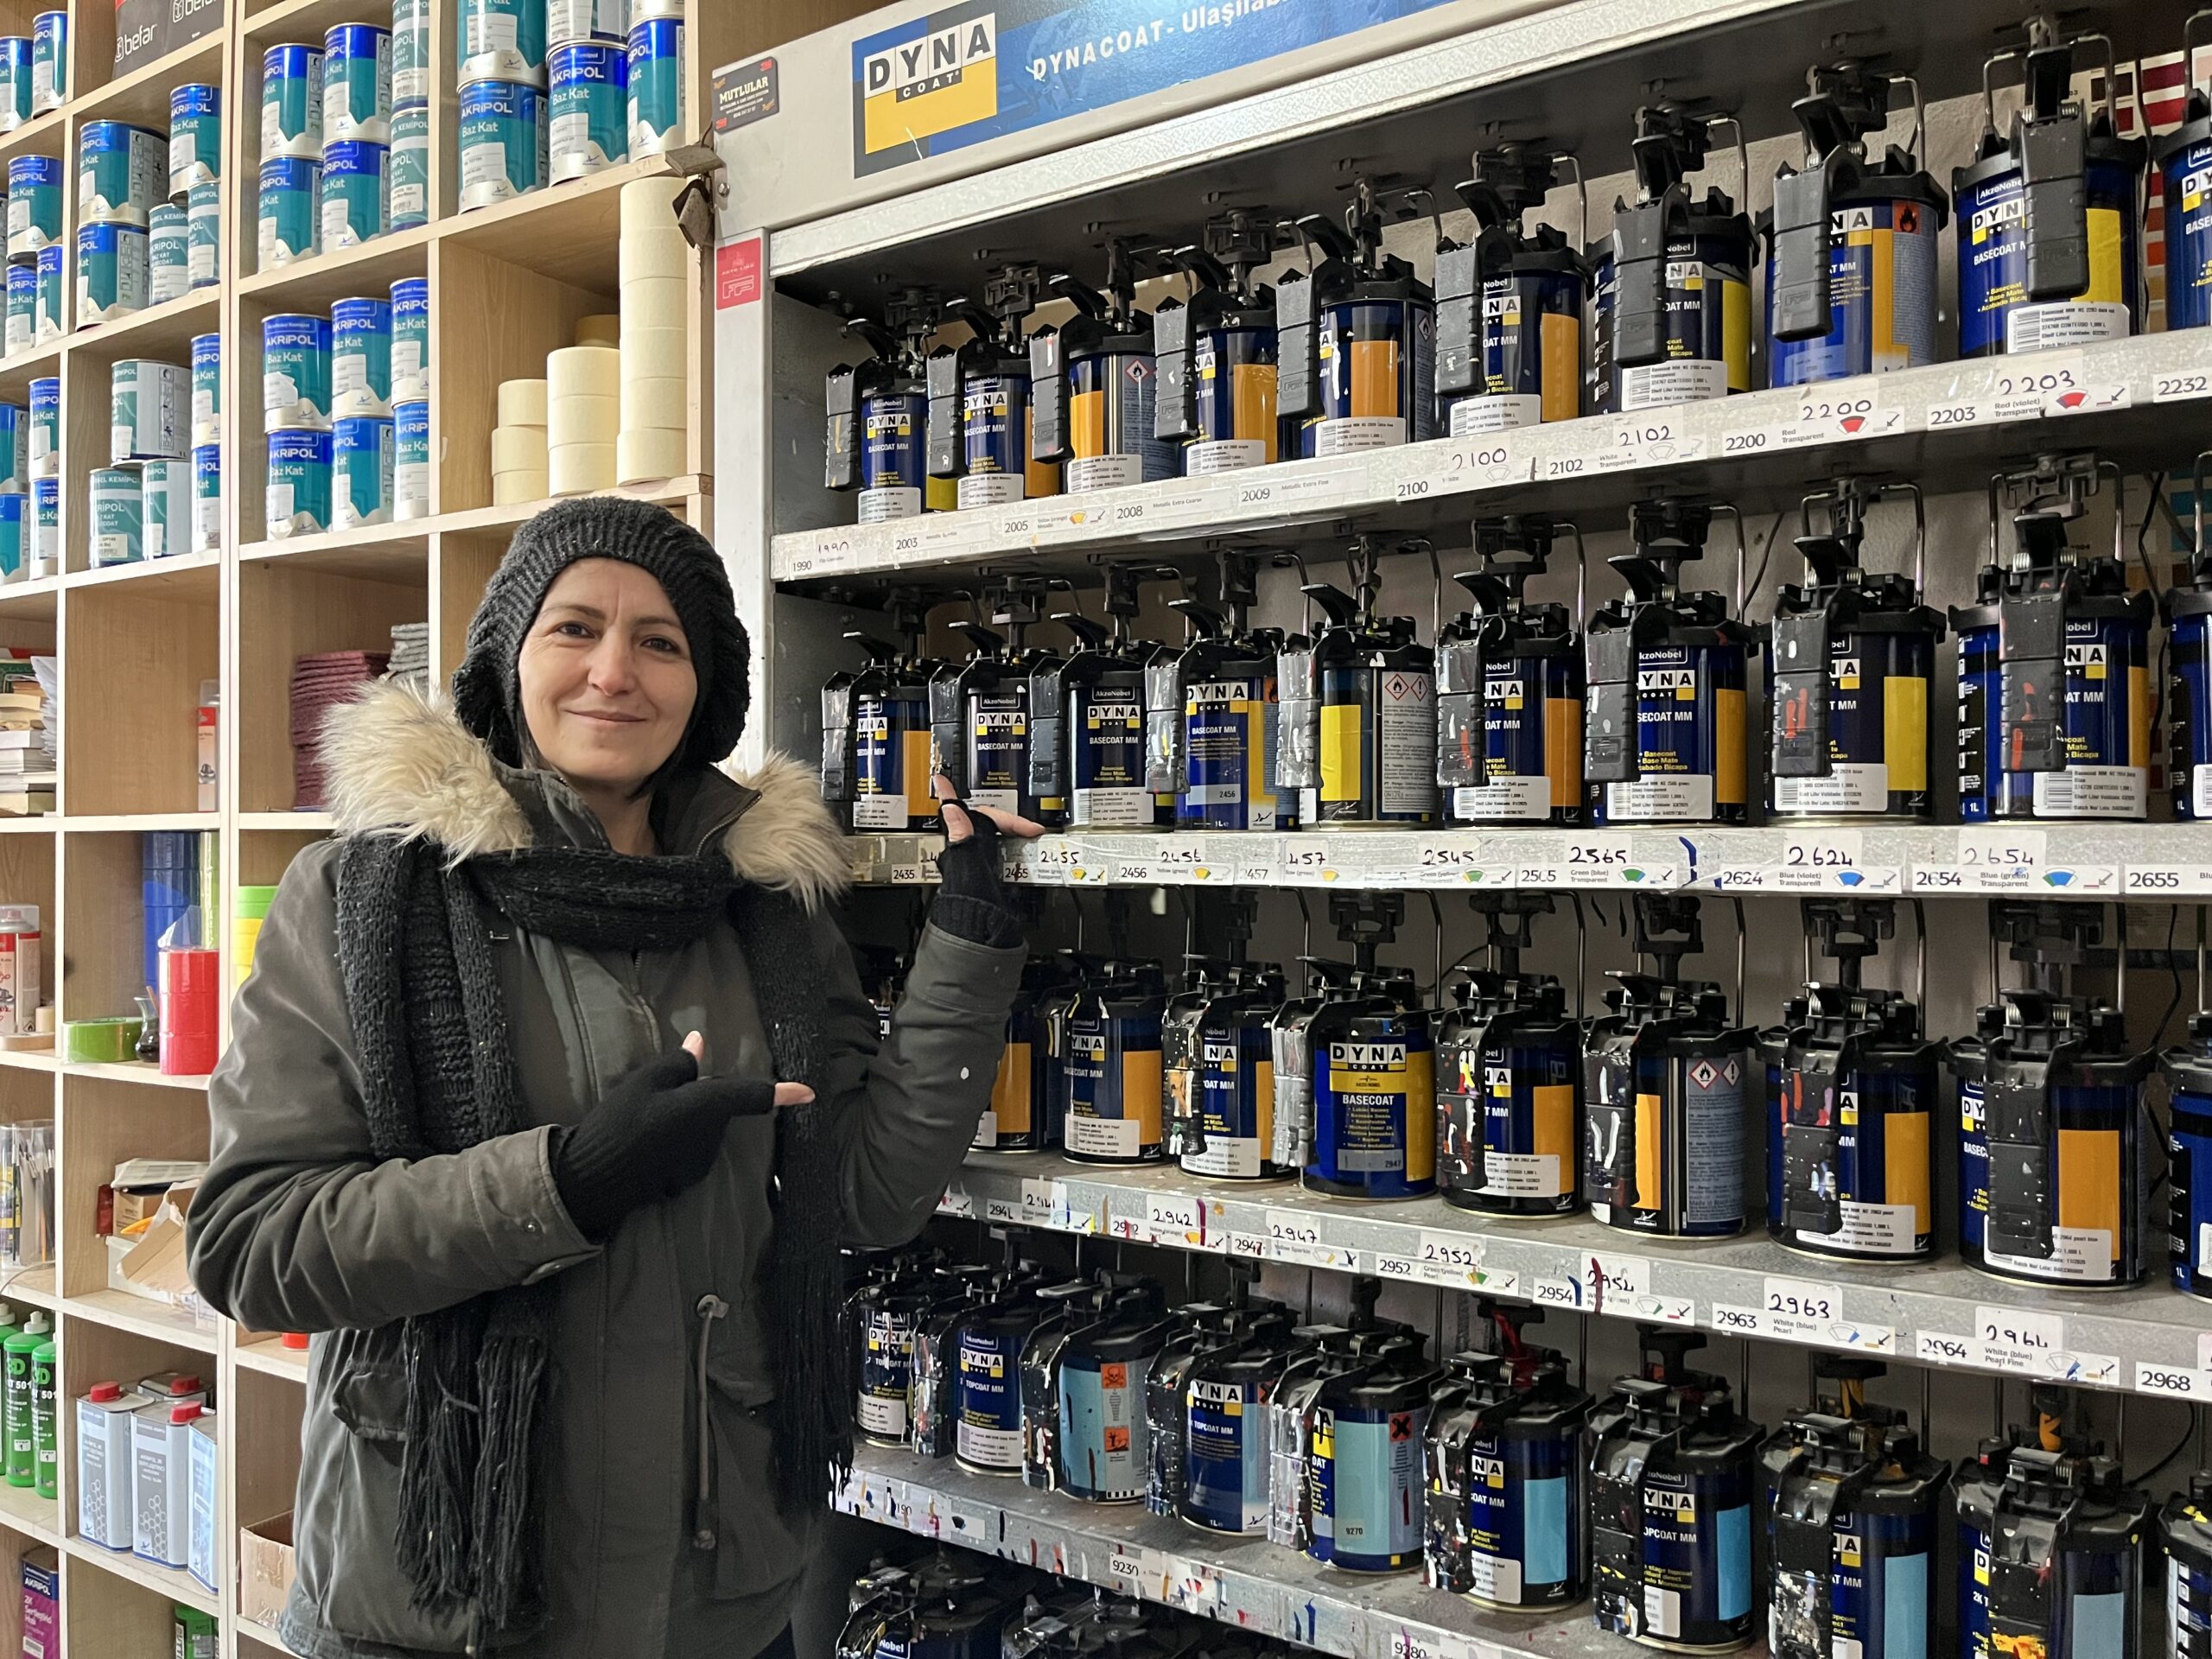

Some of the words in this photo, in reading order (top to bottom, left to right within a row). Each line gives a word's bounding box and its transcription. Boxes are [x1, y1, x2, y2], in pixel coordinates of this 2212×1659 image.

[124, 24, 157, 55] befar
[868, 23, 993, 92] DYNA
[719, 76, 769, 105] MUTLULAR
[902, 72, 956, 99] COAT
[552, 92, 567, 104] Baz
[568, 88, 589, 100] Kat
[182, 119, 199, 130] Kat
[462, 124, 477, 134] Baz
[478, 122, 499, 133] Kat
[19, 188, 35, 197] Kat
[1974, 203, 2020, 228] DYN
[1974, 243, 2016, 265] BASECOAT
[1840, 262, 1856, 273] MM
[1991, 282, 2023, 295] Basecoat
[1683, 301, 1700, 311] MM
[393, 321, 408, 332] Baz
[409, 319, 426, 331] Kat
[347, 336, 363, 347] Kat
[1501, 336, 1518, 346] MM
[267, 353, 282, 364] Baz
[283, 352, 303, 363] Kat
[1999, 370, 2076, 396] 2203
[2158, 376, 2208, 397] 2232
[964, 392, 1007, 410] DYNA
[1802, 400, 1872, 422] 2200
[1931, 407, 1976, 426] 2203
[2012, 397, 2040, 409] (violet)
[1995, 405, 2043, 417] Transparent
[868, 414, 910, 429] DYNA
[992, 423, 1006, 433] MM
[1618, 426, 1675, 447] 2102
[1726, 434, 1766, 450] 2200
[1782, 432, 1825, 443] Transparent
[397, 442, 414, 454] Baz
[868, 443, 894, 454] BASECOAT
[896, 442, 909, 452] MM
[1452, 448, 1508, 470] 2100
[1550, 459, 1583, 474] 2102
[1599, 453, 1618, 461] White
[1599, 458, 1637, 468] Transparent
[270, 466, 284, 476] Baz
[285, 465, 304, 476] Kat
[1242, 487, 1270, 502] 2009
[1397, 481, 1429, 497] 2100
[1117, 505, 1143, 519] 2008
[1005, 520, 1028, 533] 2005
[896, 537, 918, 550] 2003
[2083, 691, 2104, 702] MM
[1838, 700, 1857, 710] MM
[1089, 706, 1139, 718] DYNA
[1675, 712, 1693, 721] MM
[977, 714, 1024, 726] DYNA
[1503, 720, 1521, 730] MM
[1224, 725, 1236, 734] MM
[977, 742, 1009, 751] BASECOAT
[1011, 741, 1023, 750] MM
[1090, 737, 1122, 746] BASECOAT
[1219, 791, 1236, 799] 2456
[1040, 850, 1080, 864] 2455
[1422, 849, 1475, 866] 2545
[1568, 846, 1626, 864] 2565
[1788, 846, 1853, 866] 2624
[1962, 847, 2034, 866] 2654
[893, 869, 915, 880] 2435
[1121, 867, 1147, 879] 2456
[1723, 871, 1763, 885] 2624
[1796, 871, 1821, 880] (violet)
[1916, 872, 1961, 886] 2654
[1779, 879, 1821, 887] Transparent
[1980, 880, 2028, 888] Transparent
[2129, 873, 2179, 888] 2655
[1332, 1045, 1404, 1062] DYNA
[1090, 1069, 1103, 1079] MM
[1219, 1081, 1235, 1090] MM
[1342, 1094, 1395, 1106] BASECOAT
[1491, 1106, 1510, 1118] MM
[1384, 1160, 1402, 1169] 2947
[1154, 1208, 1193, 1226] 2942
[1114, 1220, 1139, 1235] 292
[1273, 1224, 1318, 1243] 2947
[1425, 1244, 1476, 1267] 2952
[1380, 1259, 1411, 1275] 2952
[1538, 1285, 1573, 1303] 2954
[1768, 1294, 1830, 1319] 2963
[1716, 1310, 1758, 1330] 2963
[1773, 1318, 1795, 1328] White
[1797, 1321, 1817, 1332] (blue)
[1773, 1326, 1792, 1336] Pearl
[1986, 1325, 2049, 1350] 2964
[961, 1348, 1001, 1367] DYNA
[1985, 1346, 2008, 1357] White
[2010, 1350, 2032, 1361] (blue)
[1985, 1355, 2005, 1365] Pearl
[2008, 1357, 2024, 1367] Fine
[966, 1379, 990, 1392] TOPCOAT
[991, 1382, 1004, 1393] MM
[2140, 1370, 2191, 1392] 2968
[1221, 1425, 1234, 1435] MM
[1489, 1496, 1504, 1508] MM
[1680, 1532, 1697, 1543] MM
[1843, 1576, 1862, 1588] MM
